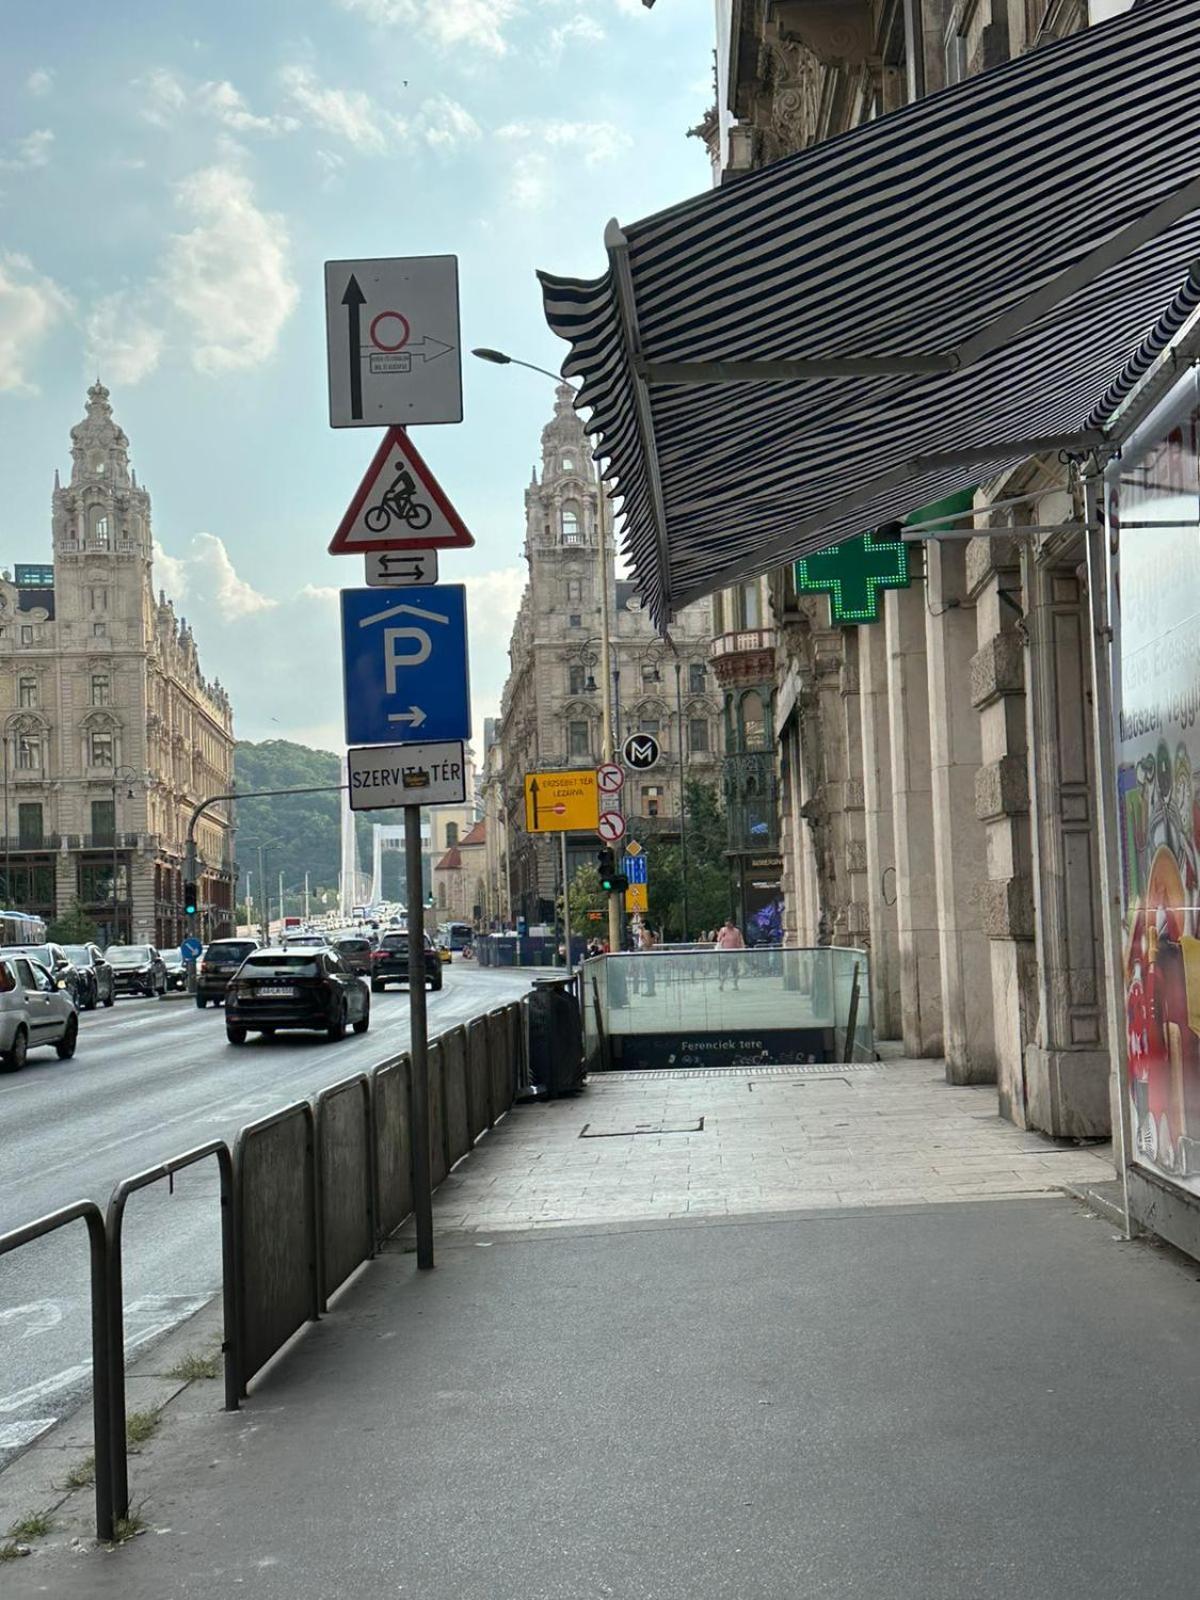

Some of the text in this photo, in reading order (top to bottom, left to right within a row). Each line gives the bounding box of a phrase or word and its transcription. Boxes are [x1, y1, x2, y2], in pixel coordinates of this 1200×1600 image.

[384, 627, 432, 694] P
[632, 742, 652, 762] M
[431, 760, 460, 782] TÉR
[738, 1040, 762, 1050] tere
